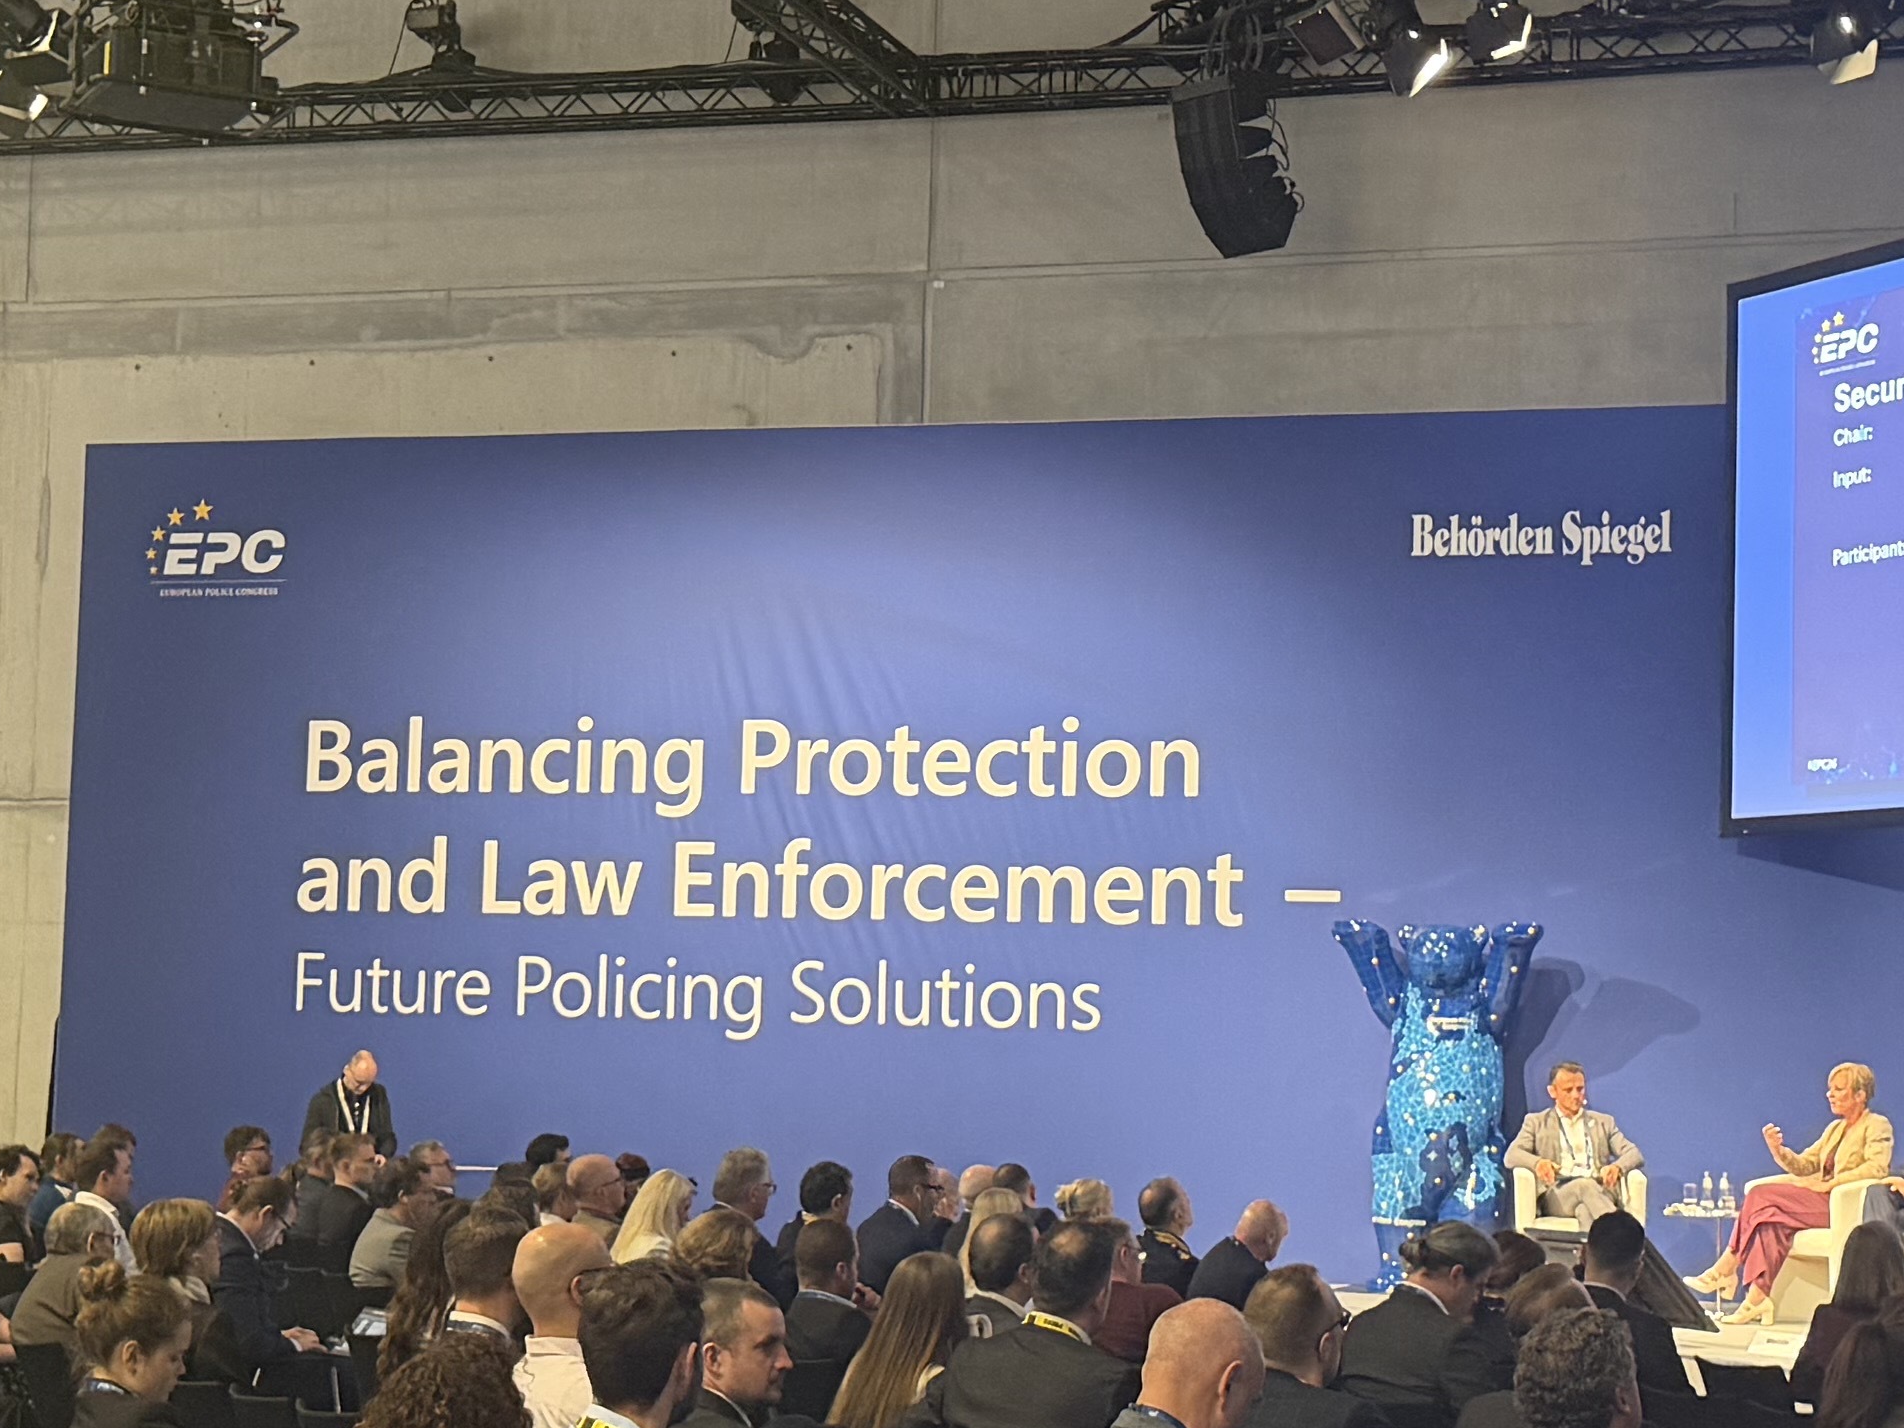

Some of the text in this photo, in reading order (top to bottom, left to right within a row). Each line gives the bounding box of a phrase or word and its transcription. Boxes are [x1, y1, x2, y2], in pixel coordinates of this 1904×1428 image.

[1819, 323, 1879, 364] EPC
[1833, 424, 1874, 447] Chair:
[1833, 466, 1872, 490] Input:
[162, 529, 286, 575] EPC
[1410, 509, 1672, 566] Behörden Spiegel
[305, 715, 1200, 819] Balancing Protection
[296, 835, 448, 914] and
[481, 839, 643, 916] Law
[673, 837, 1244, 928] Enforcement
[295, 952, 1101, 1041] Future Policing Solutions
